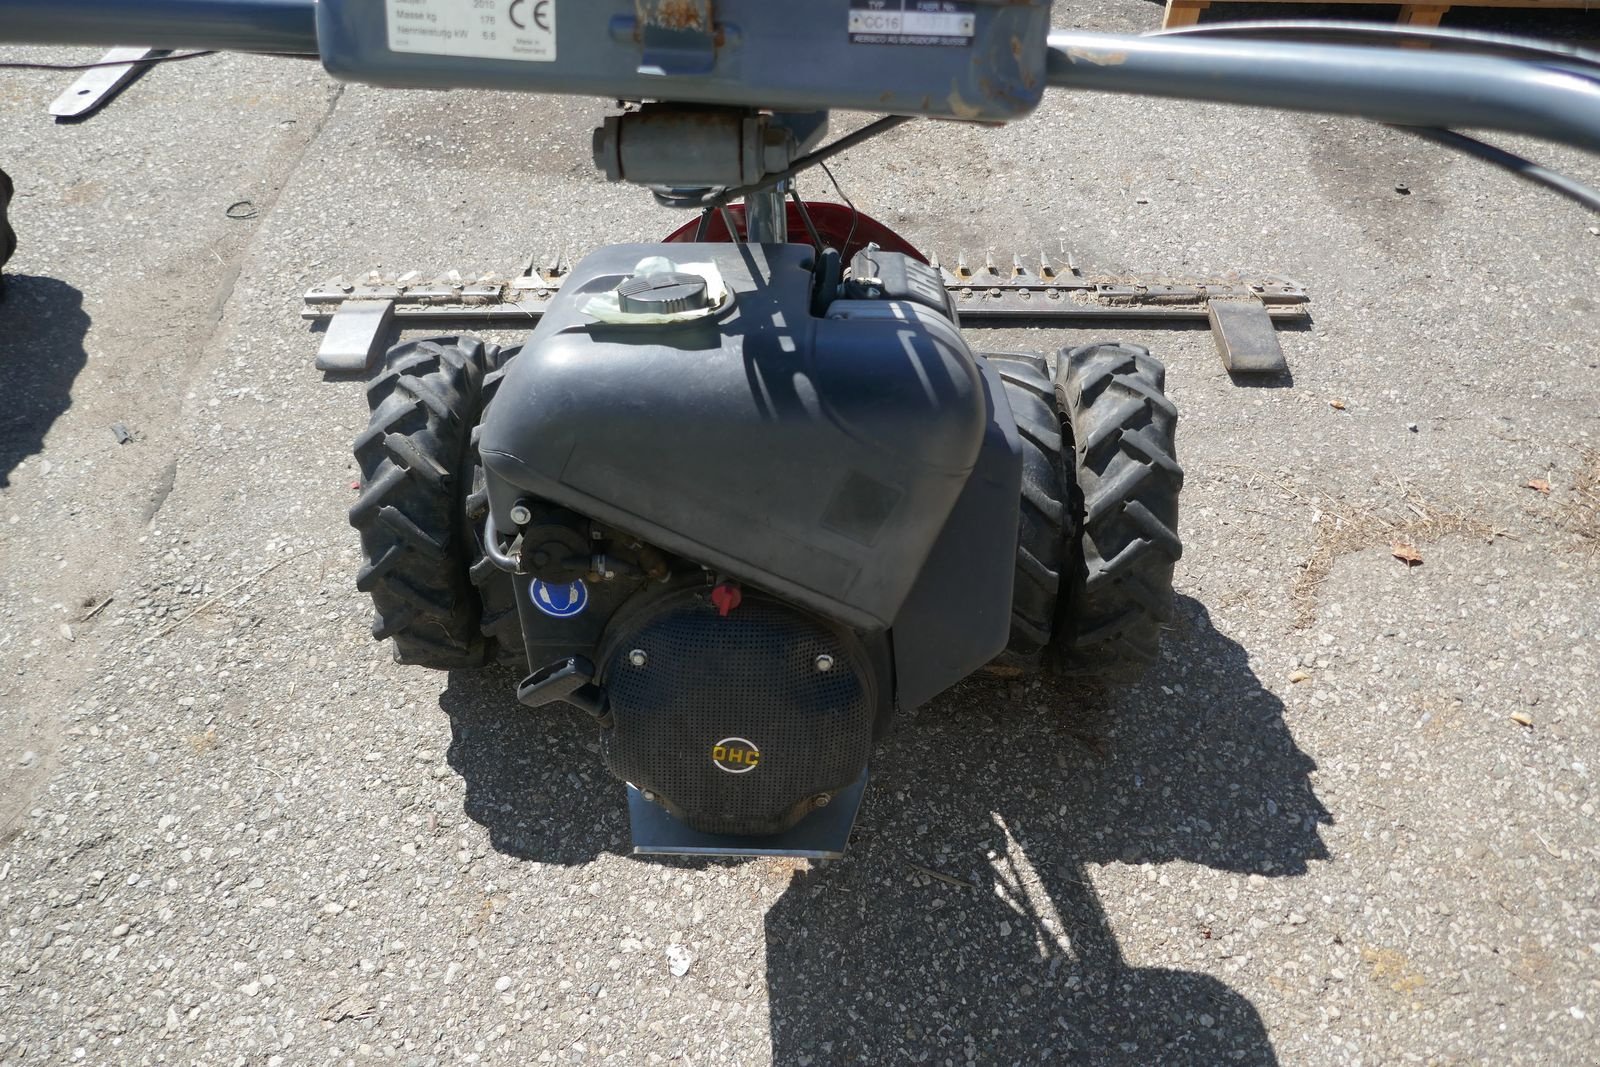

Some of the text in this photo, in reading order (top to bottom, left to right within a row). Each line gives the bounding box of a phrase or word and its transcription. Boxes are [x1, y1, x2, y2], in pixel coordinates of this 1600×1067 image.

[396, 9, 438, 23] Masse kg
[864, 16, 899, 30] CC16
[712, 746, 760, 766] OHC
